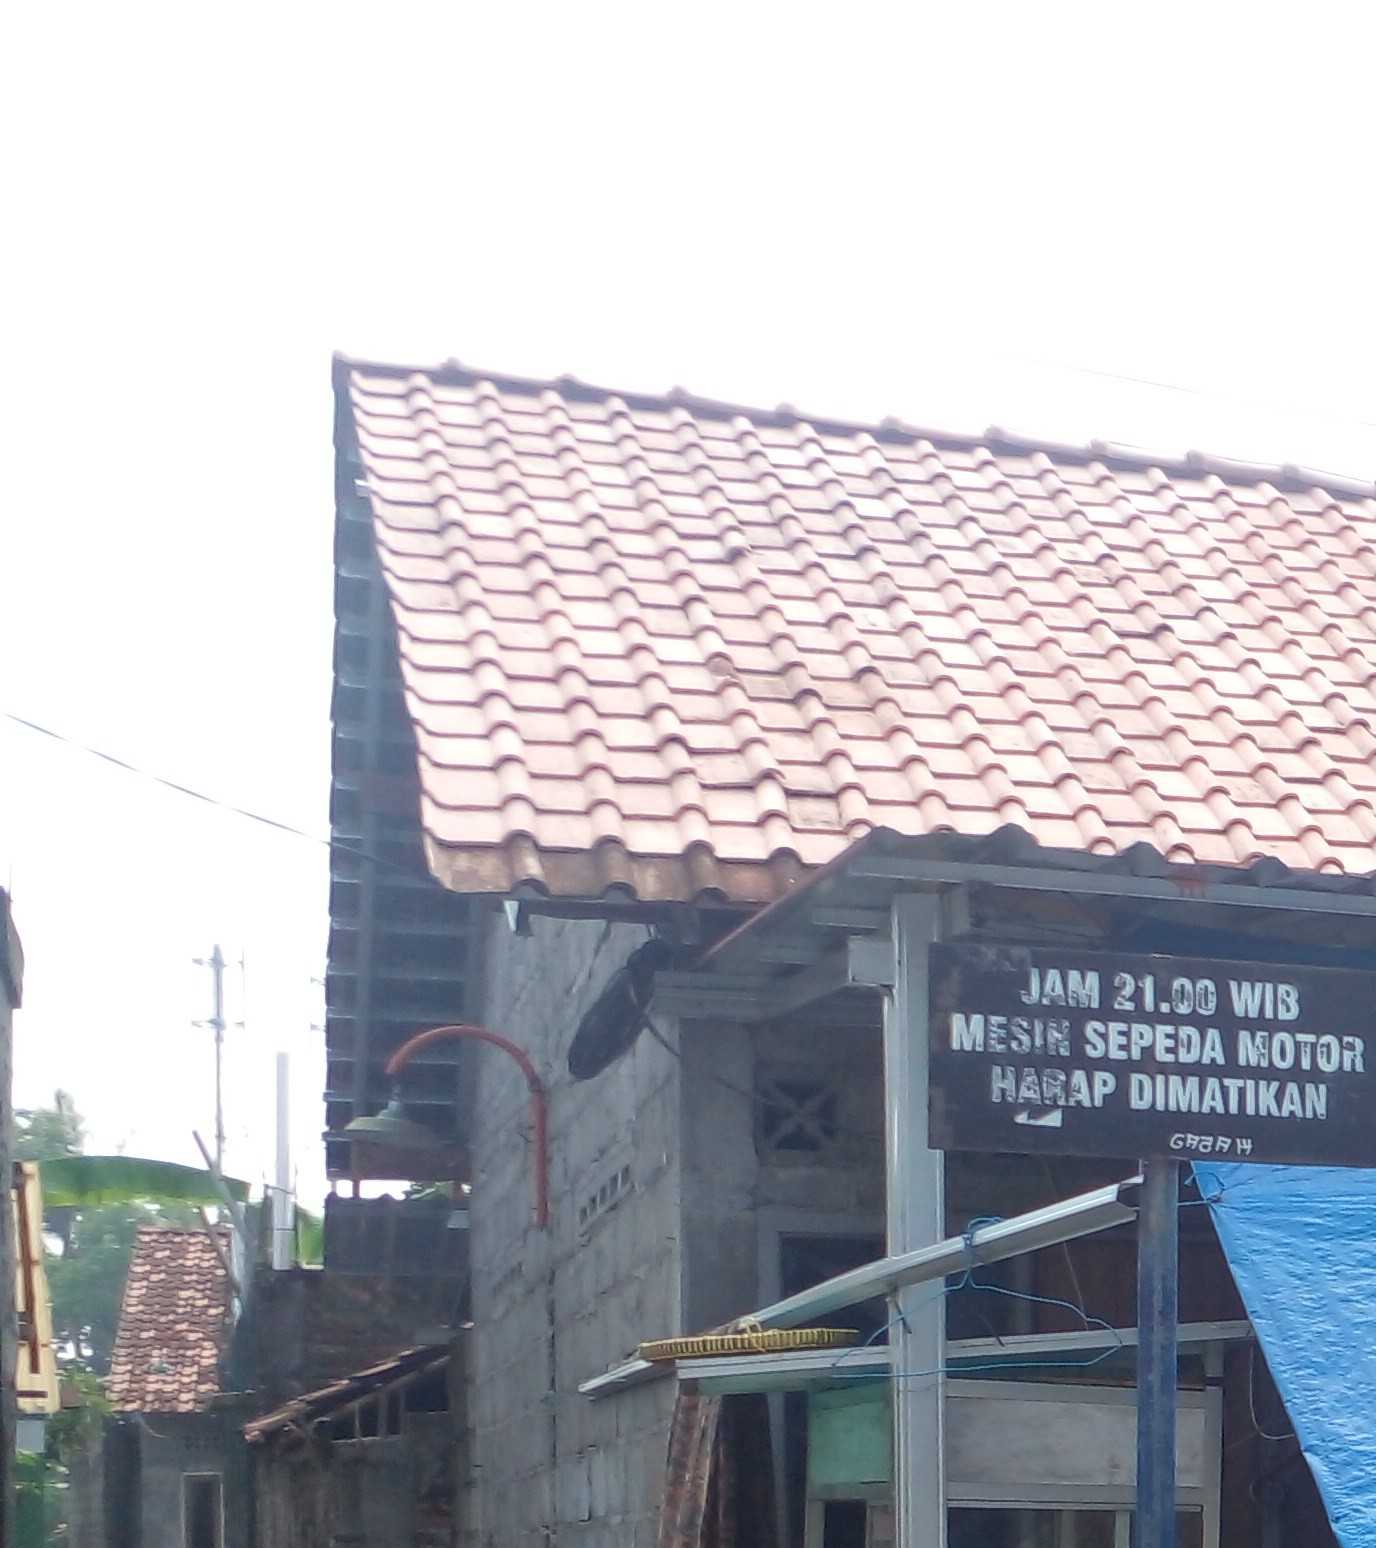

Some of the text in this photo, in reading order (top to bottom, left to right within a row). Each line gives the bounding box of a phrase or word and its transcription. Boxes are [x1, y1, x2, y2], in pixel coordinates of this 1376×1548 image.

[1020, 967, 1300, 1021] JAM 21.00 WIB
[950, 1012, 1365, 1073] MESIN SEPEDA MOTOR
[991, 1065, 1327, 1120] HARAP DIMATIKAN
